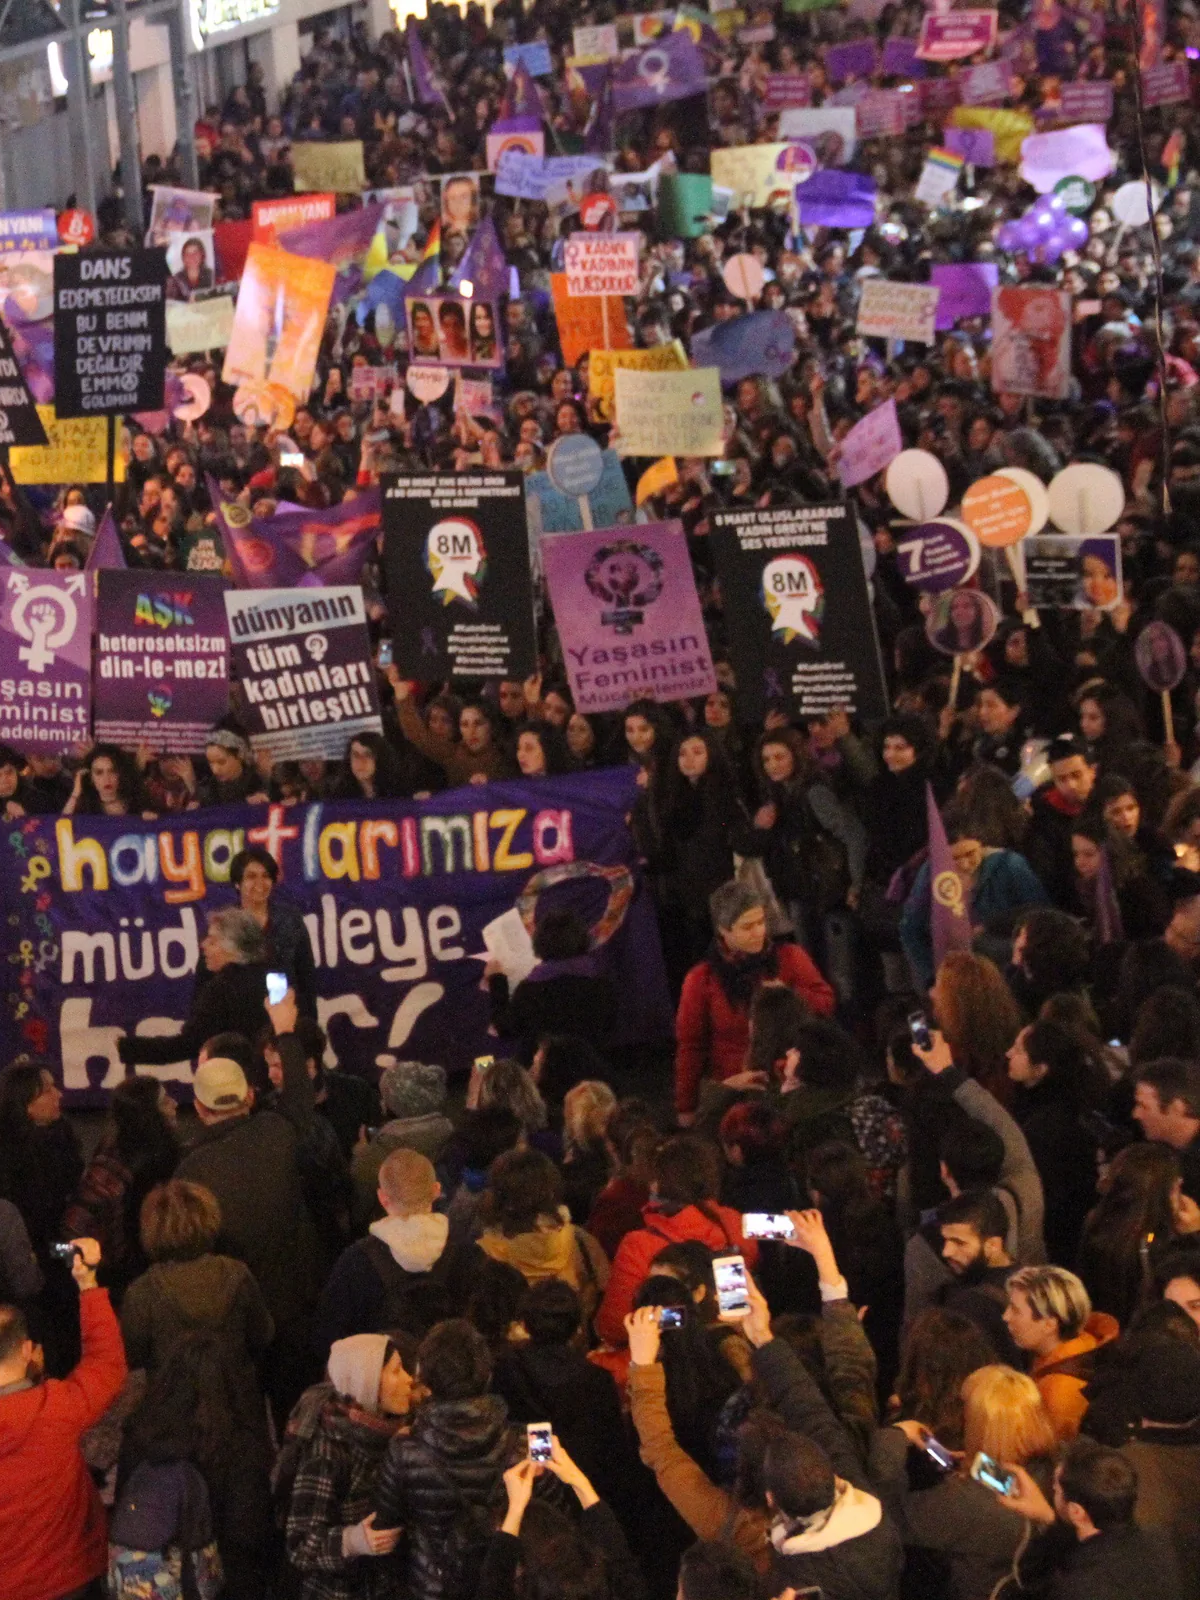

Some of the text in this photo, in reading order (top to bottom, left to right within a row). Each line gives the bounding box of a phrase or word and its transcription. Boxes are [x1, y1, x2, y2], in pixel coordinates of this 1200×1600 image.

[80, 256, 132, 281] DANS
[76, 313, 98, 334] BU
[437, 535, 472, 555] 8M
[897, 539, 925, 573] 7
[772, 571, 808, 593] 8M
[134, 590, 194, 630] AŞK
[231, 595, 356, 636] dünyanın
[100, 633, 227, 653] heteroseksizm
[246, 643, 302, 673] tüm
[568, 634, 700, 667] Yaşasın
[100, 656, 227, 679] din-le-mez!
[243, 661, 371, 704] kadınları
[574, 655, 709, 690] Feminist
[259, 687, 373, 730] birleşti!
